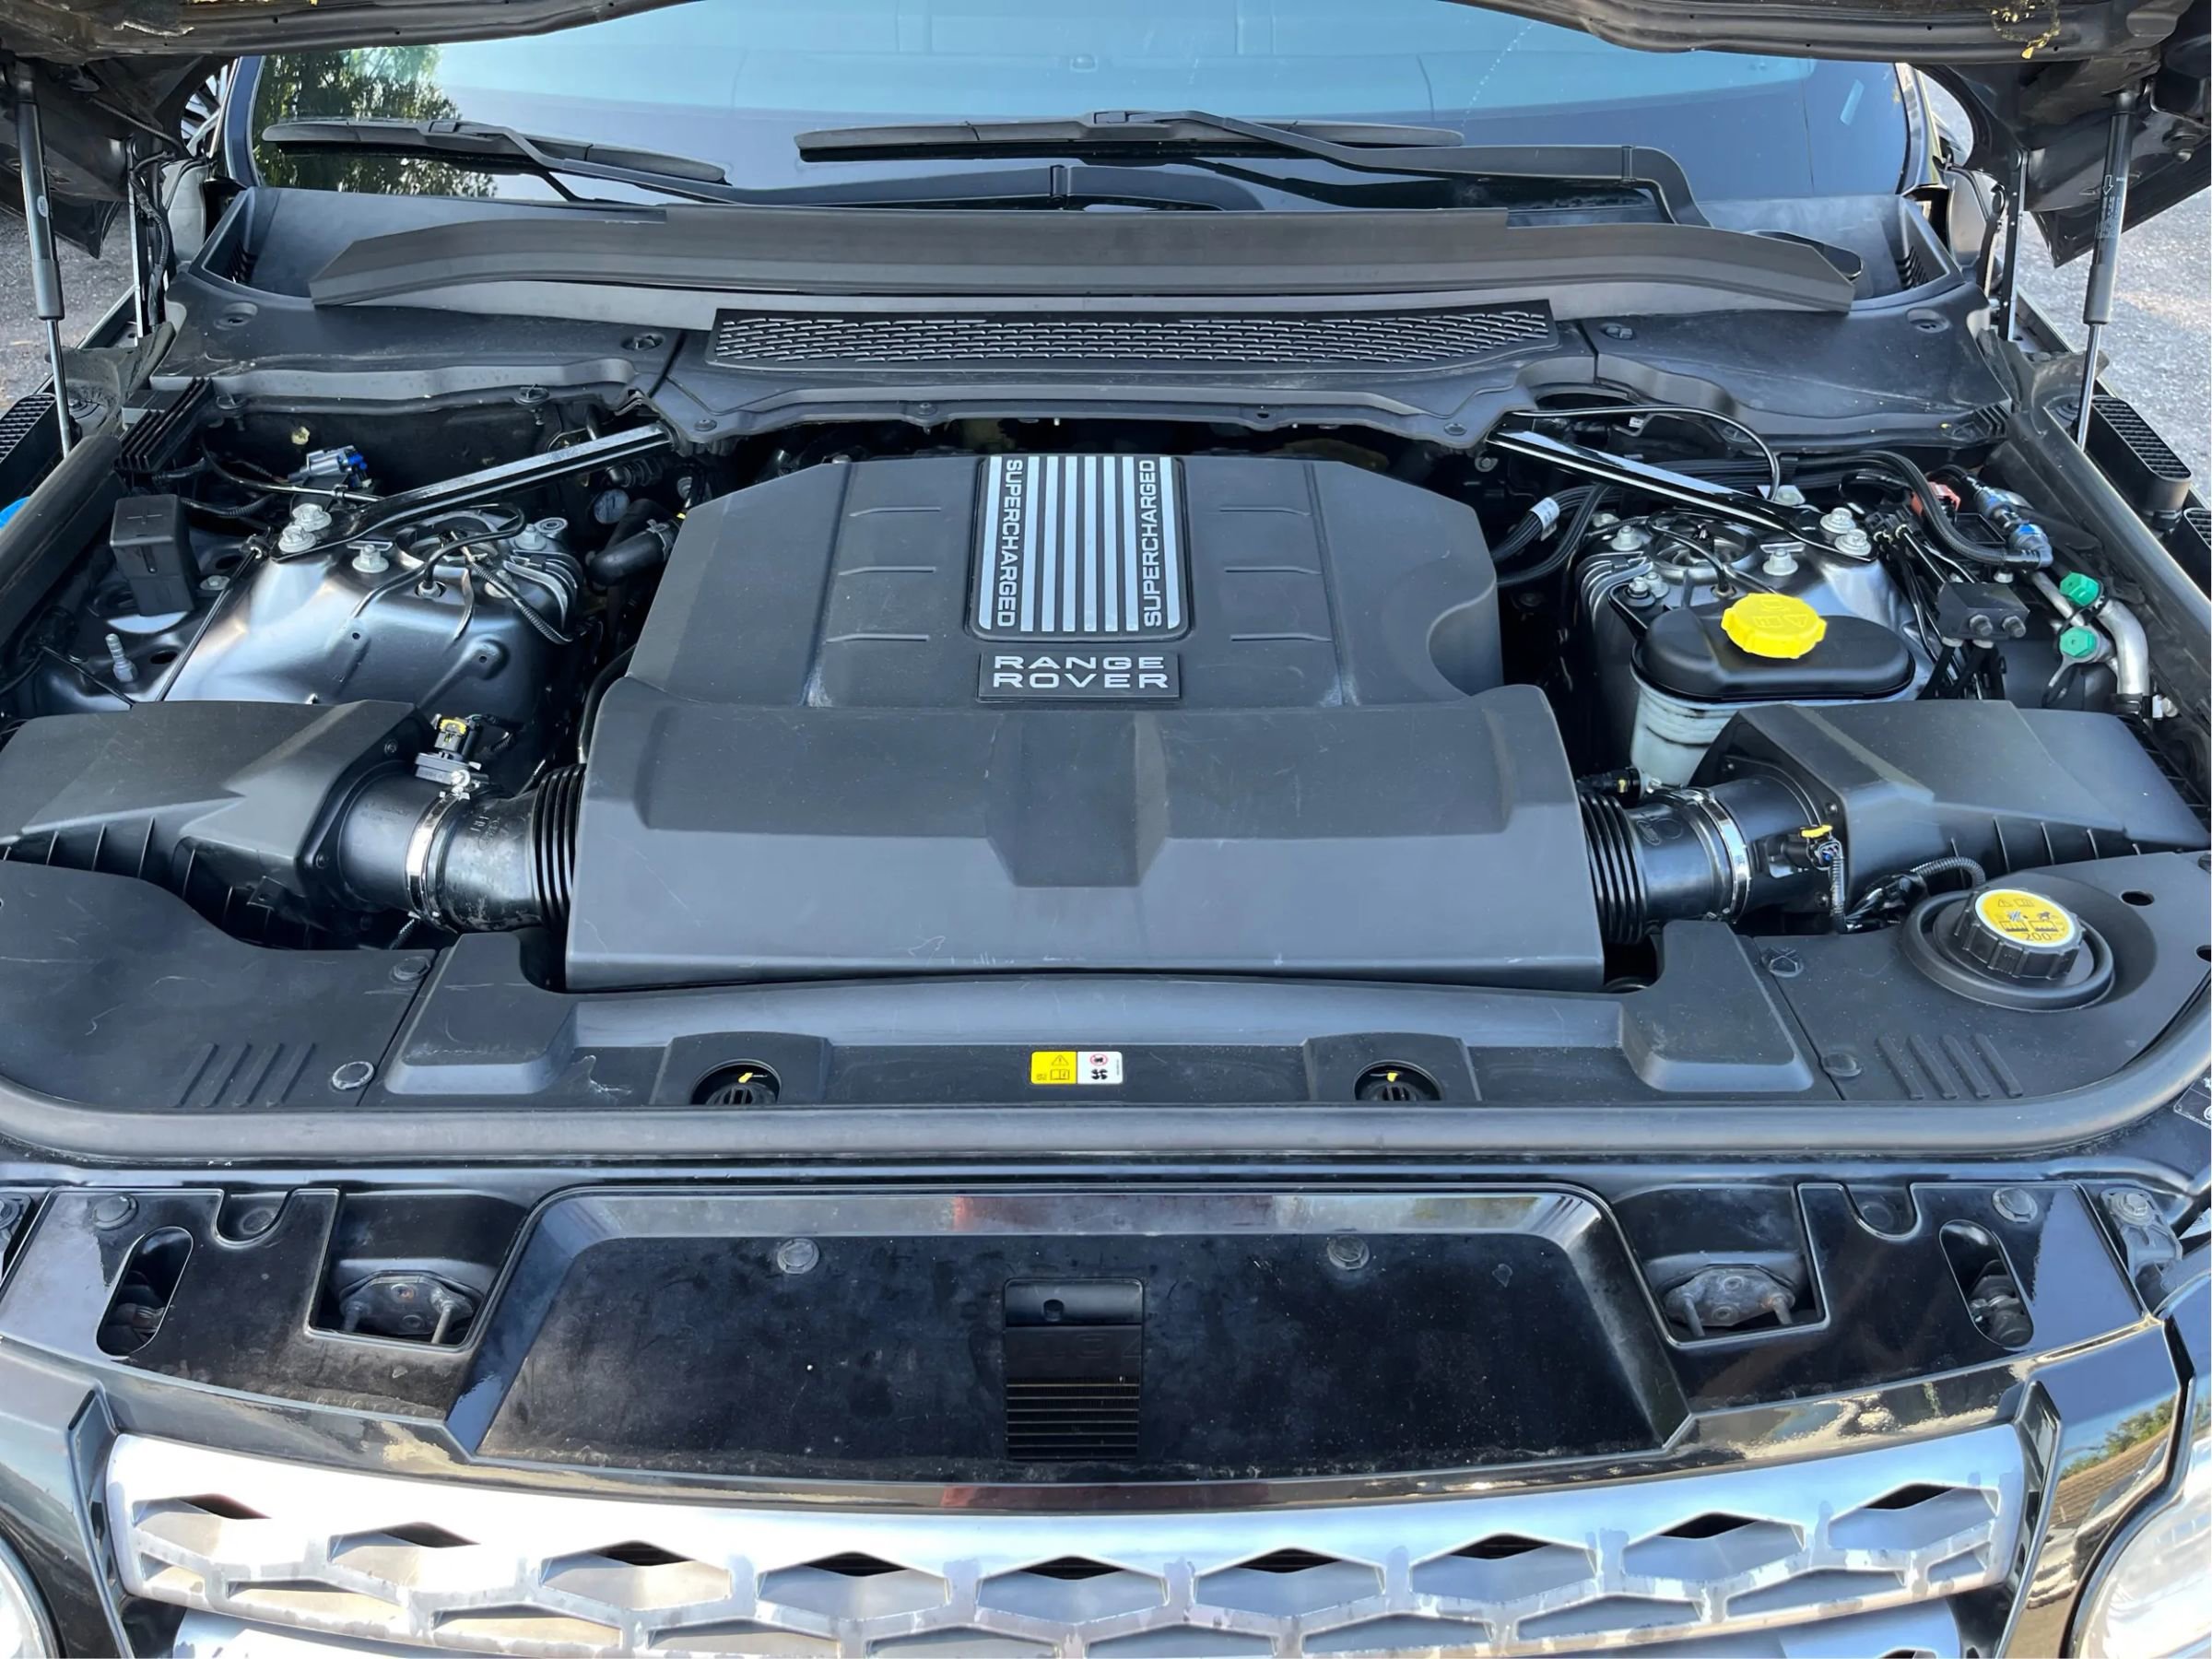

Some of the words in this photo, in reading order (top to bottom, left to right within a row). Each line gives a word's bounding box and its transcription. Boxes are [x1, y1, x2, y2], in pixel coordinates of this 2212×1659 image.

[997, 459, 1023, 628] SUPERCHARGED
[1138, 460, 1162, 628] SUPERCHARGED
[992, 673, 1169, 688] ROVER
[994, 655, 1165, 670] RANGE
